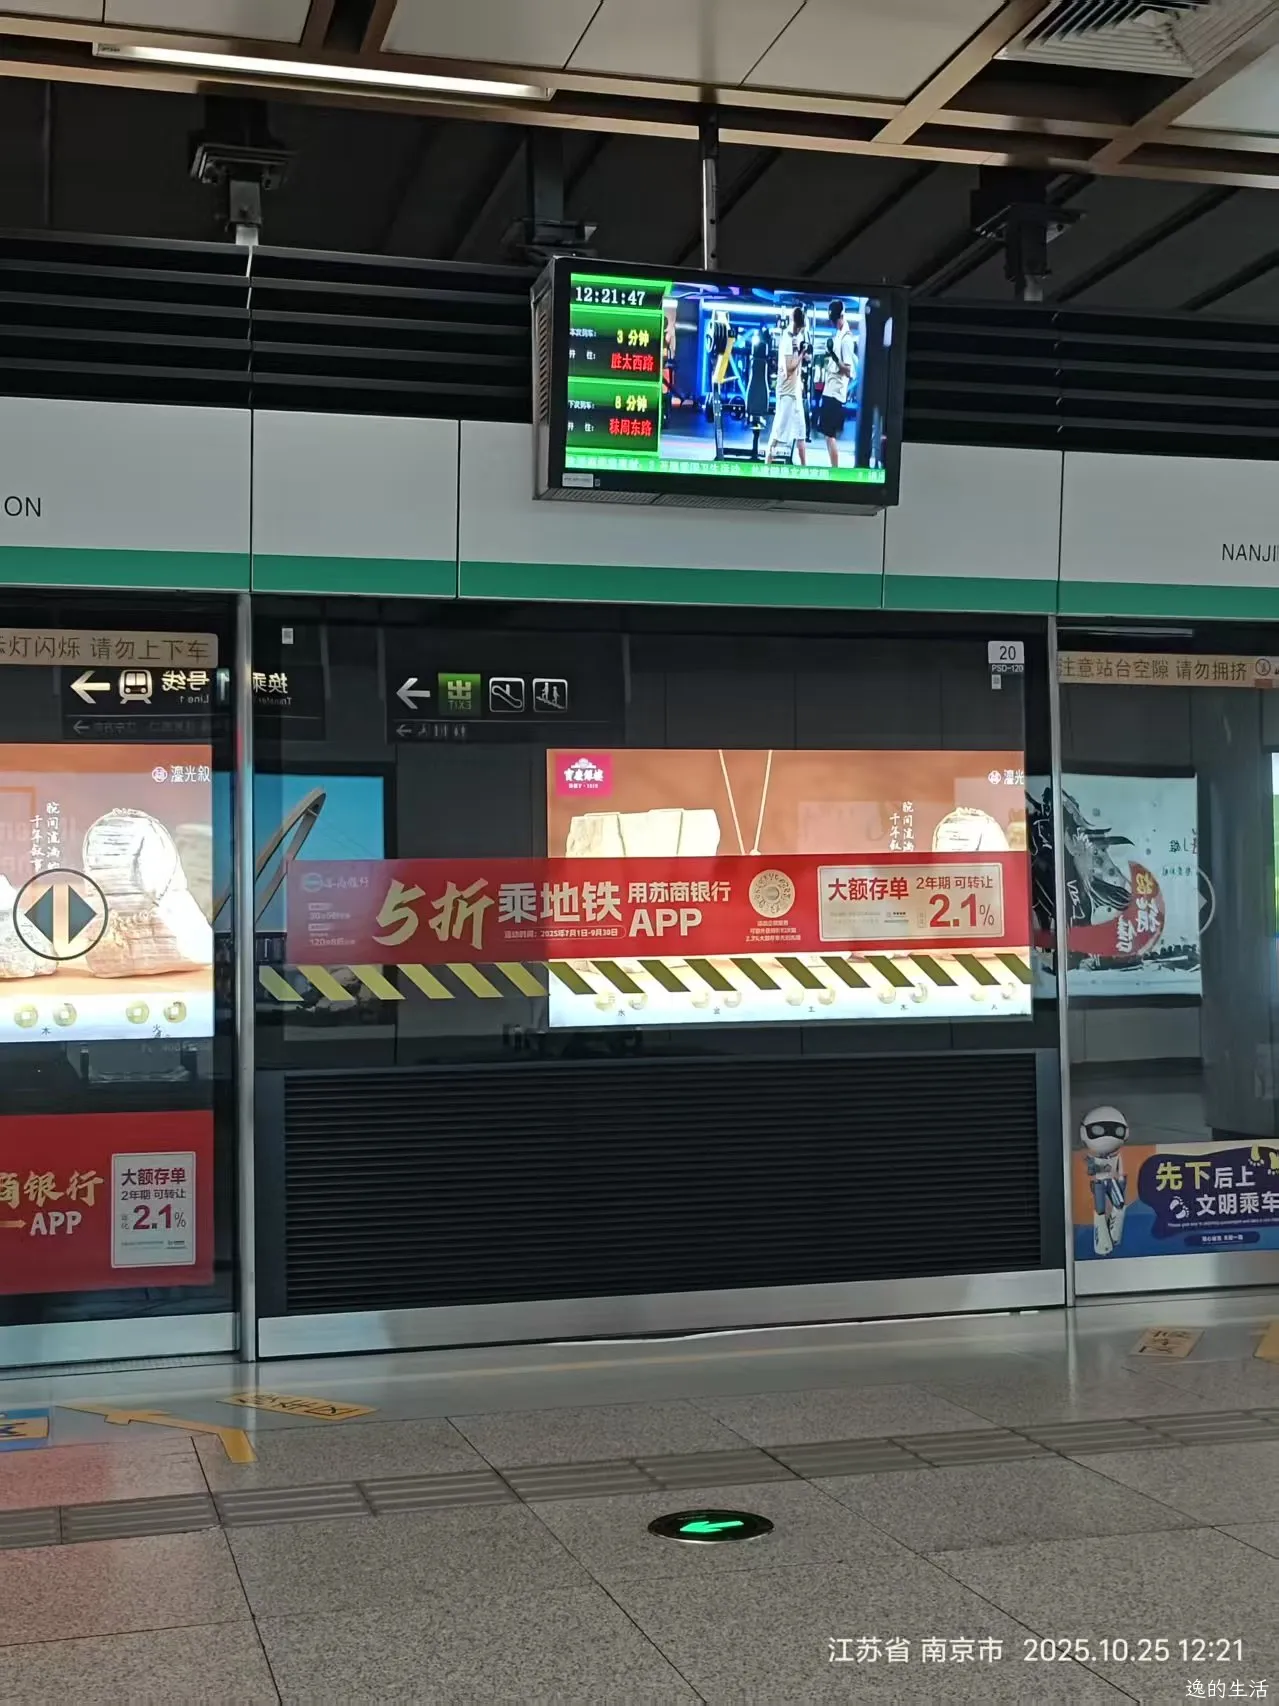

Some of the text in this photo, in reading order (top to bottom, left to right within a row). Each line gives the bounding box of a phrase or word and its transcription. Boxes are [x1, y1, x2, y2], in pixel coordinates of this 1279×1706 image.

[575, 286, 646, 306] 12:21:47
[617, 329, 650, 347] 3 分钟
[626, 394, 648, 413] 分钟
[4, 496, 41, 517] ON
[1222, 543, 1279, 562] NANJI
[0, 636, 209, 662] 灯闪烁 请勿上下车
[999, 645, 1017, 660] 20
[1176, 660, 1248, 680] 请勿拥挤
[628, 881, 731, 904] 用苏商银行
[828, 877, 909, 901] 大额存单
[916, 876, 993, 890] 2年期 可转让
[498, 881, 623, 924] 乘地铁
[929, 893, 995, 928] 2.1%
[628, 908, 703, 938] APP
[121, 1167, 186, 1187] 大额存单
[1155, 1161, 1256, 1192] 先下后上
[121, 1188, 187, 1201] 2年期 可转让
[1195, 1190, 1279, 1217] 文明乘车
[29, 1210, 82, 1237] APP
[132, 1203, 187, 1231] 2.1%
